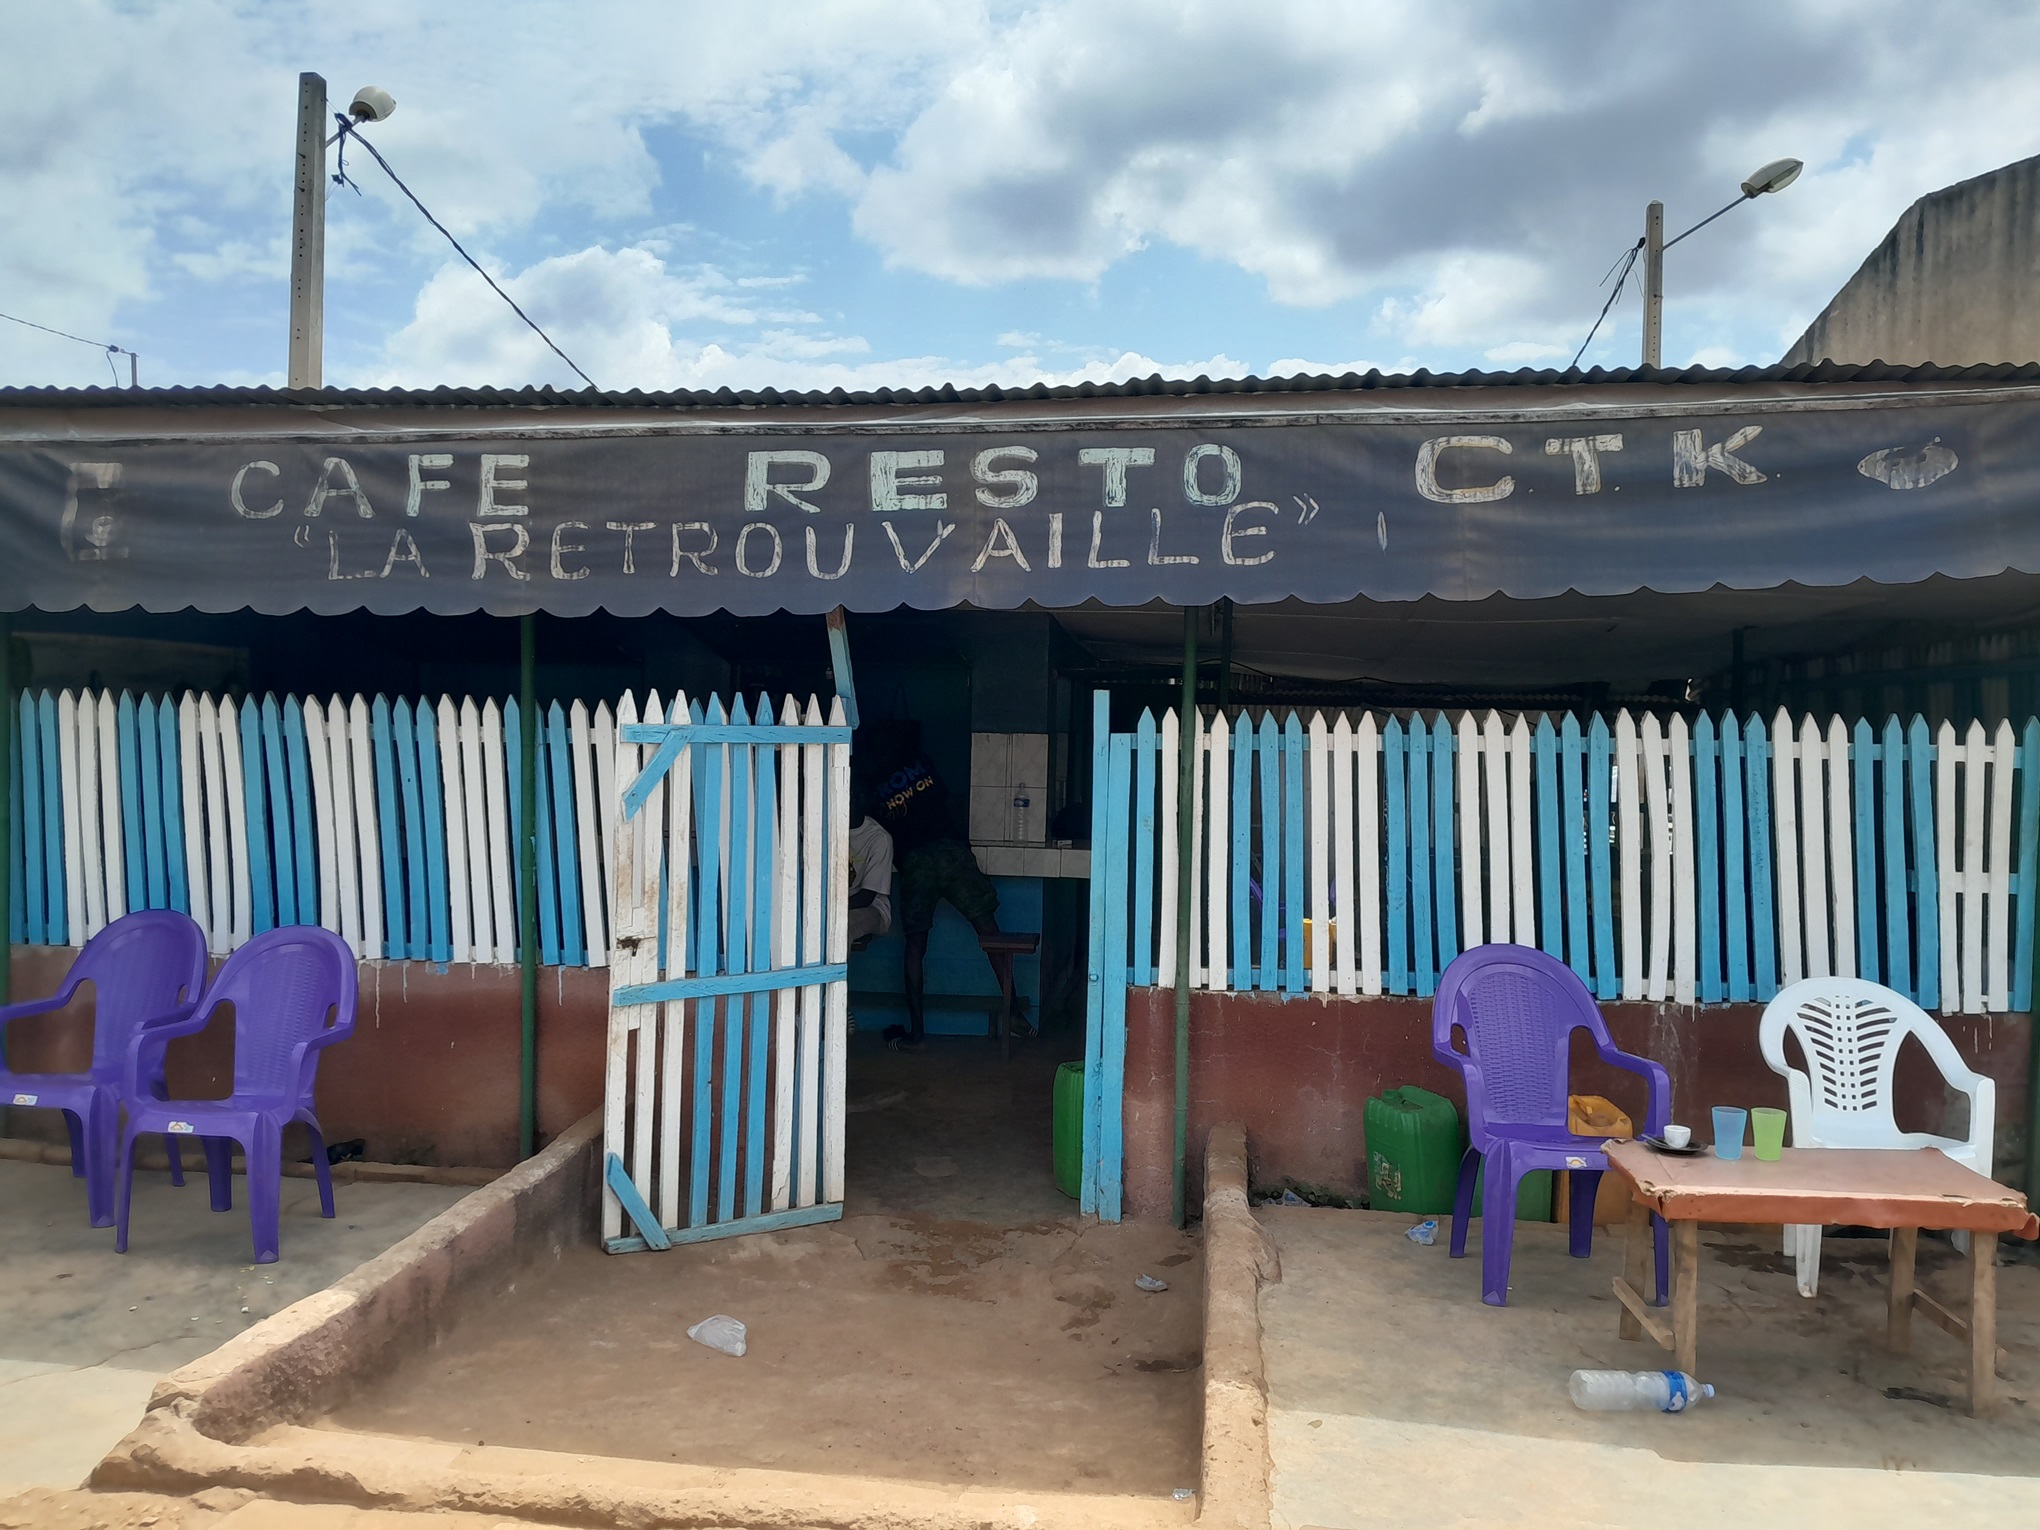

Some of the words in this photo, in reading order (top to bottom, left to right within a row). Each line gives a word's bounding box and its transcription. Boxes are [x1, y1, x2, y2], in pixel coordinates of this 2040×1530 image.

[228, 452, 531, 520] CAFE
[743, 443, 1244, 515] RESTO
[885, 786, 914, 811] NOW
[915, 775, 934, 792] ON
